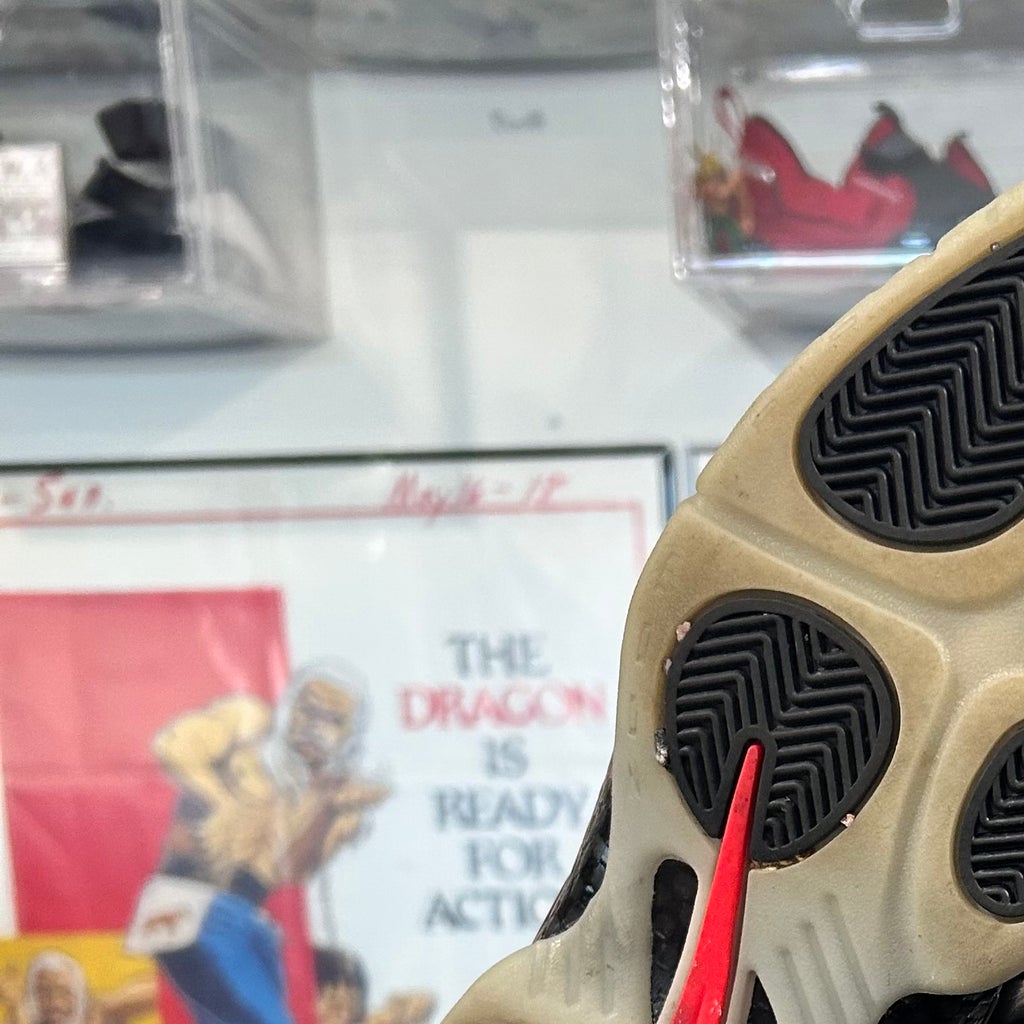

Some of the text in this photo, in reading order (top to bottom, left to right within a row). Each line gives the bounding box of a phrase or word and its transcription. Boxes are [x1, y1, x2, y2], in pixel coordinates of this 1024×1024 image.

[448, 628, 550, 680] THE
[399, 683, 606, 731] DRAGON
[482, 734, 529, 780] IS
[432, 783, 590, 832] READY
[464, 834, 565, 880] FOR
[422, 886, 560, 932] ACTIO
